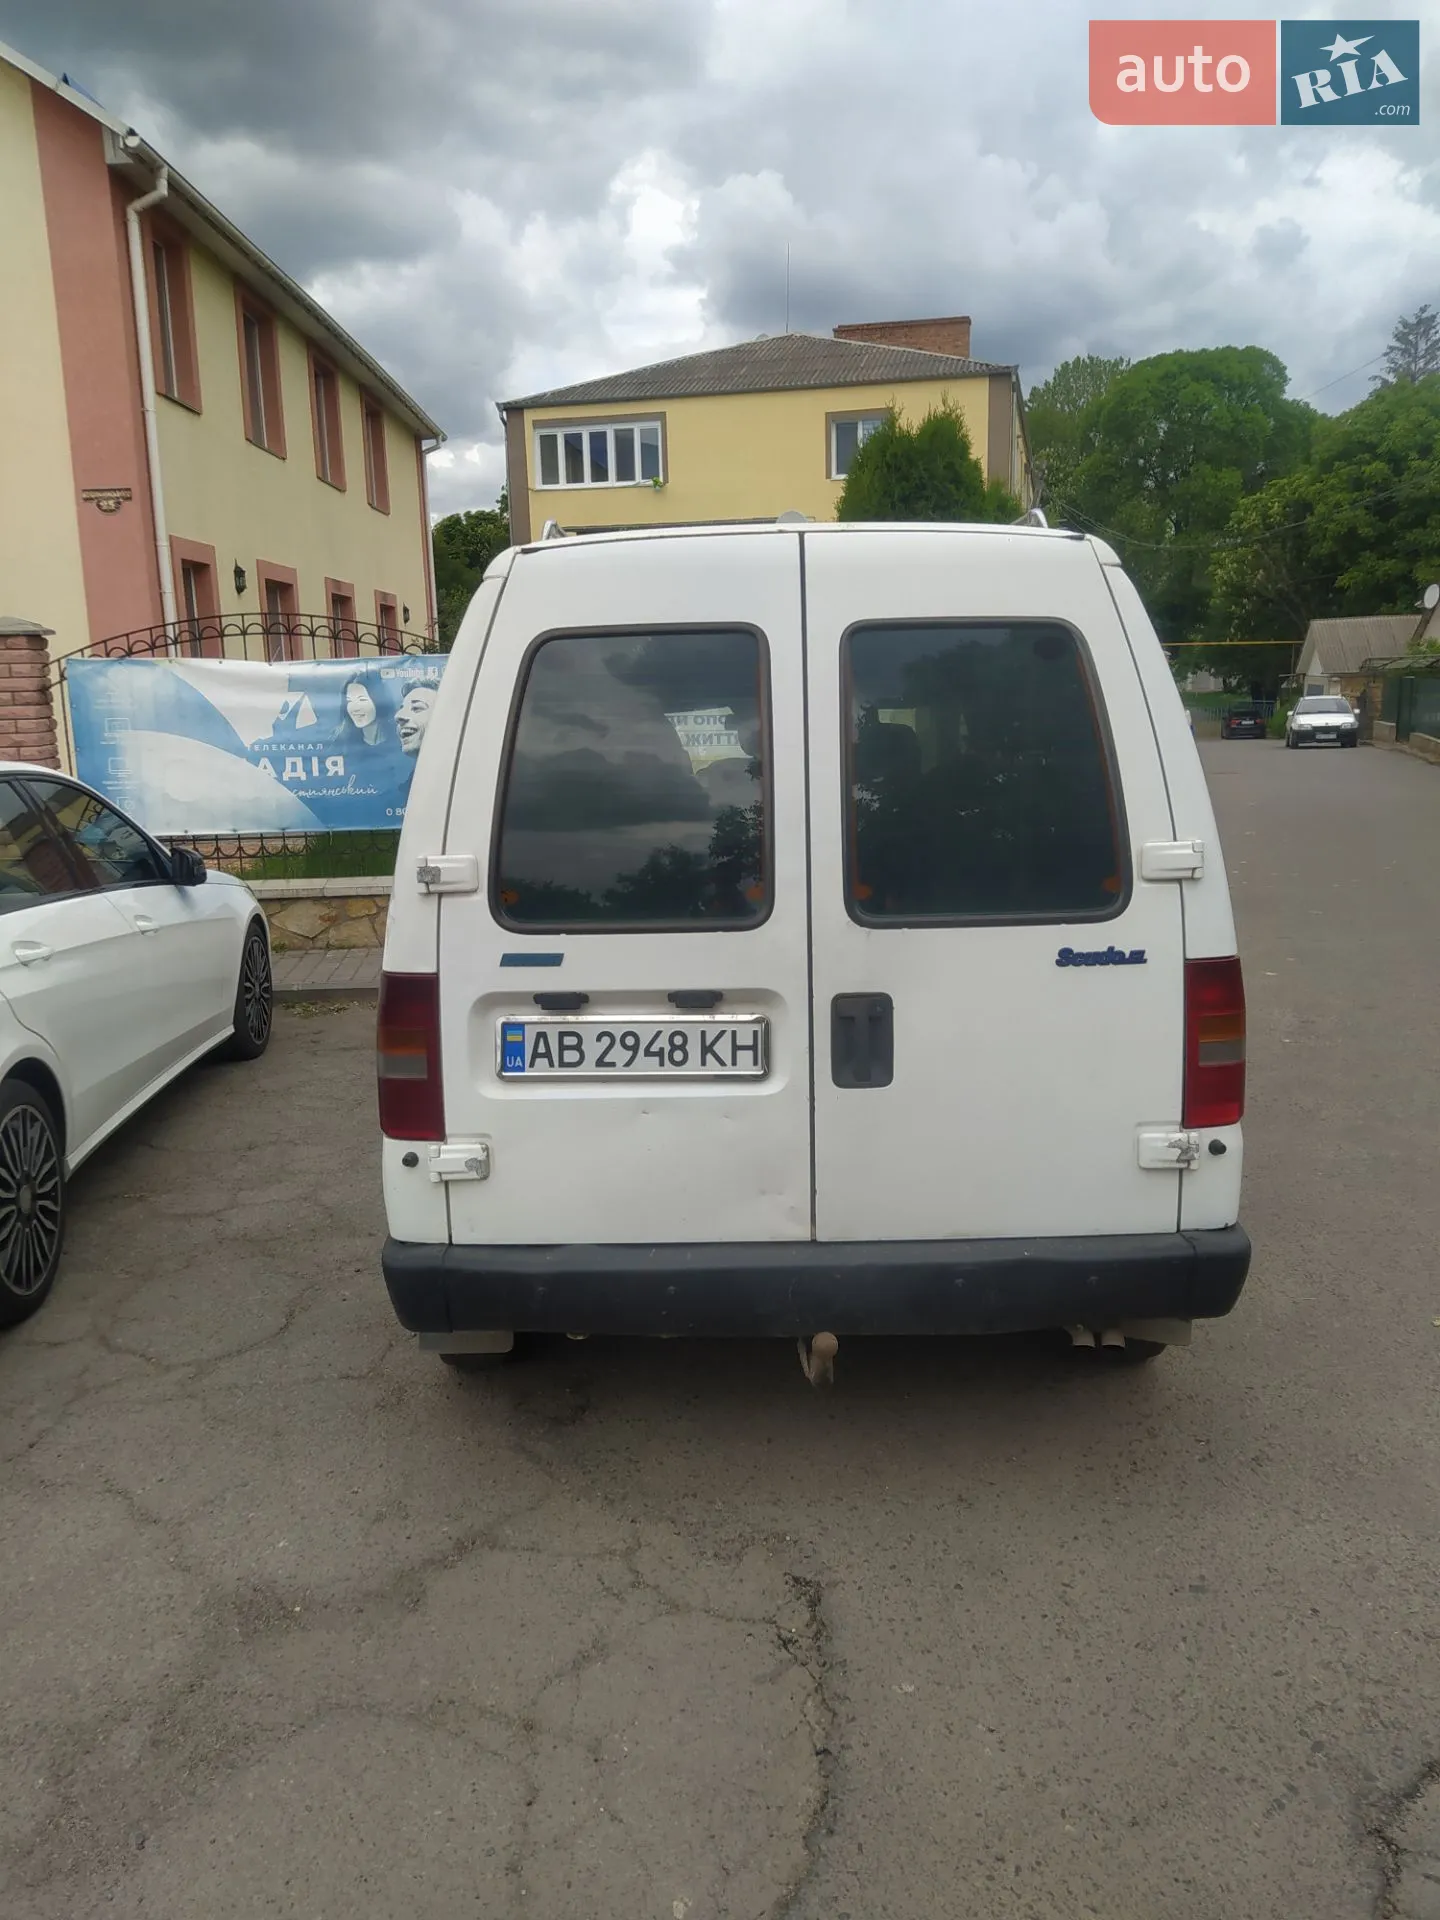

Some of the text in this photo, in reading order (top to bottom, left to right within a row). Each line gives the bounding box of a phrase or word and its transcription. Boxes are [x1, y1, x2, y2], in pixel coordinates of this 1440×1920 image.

[257, 755, 344, 781] АДІЯ
[290, 774, 378, 799] стиянський
[506, 1055, 524, 1068] UA
[528, 1029, 760, 1069] AB 2948 KH
